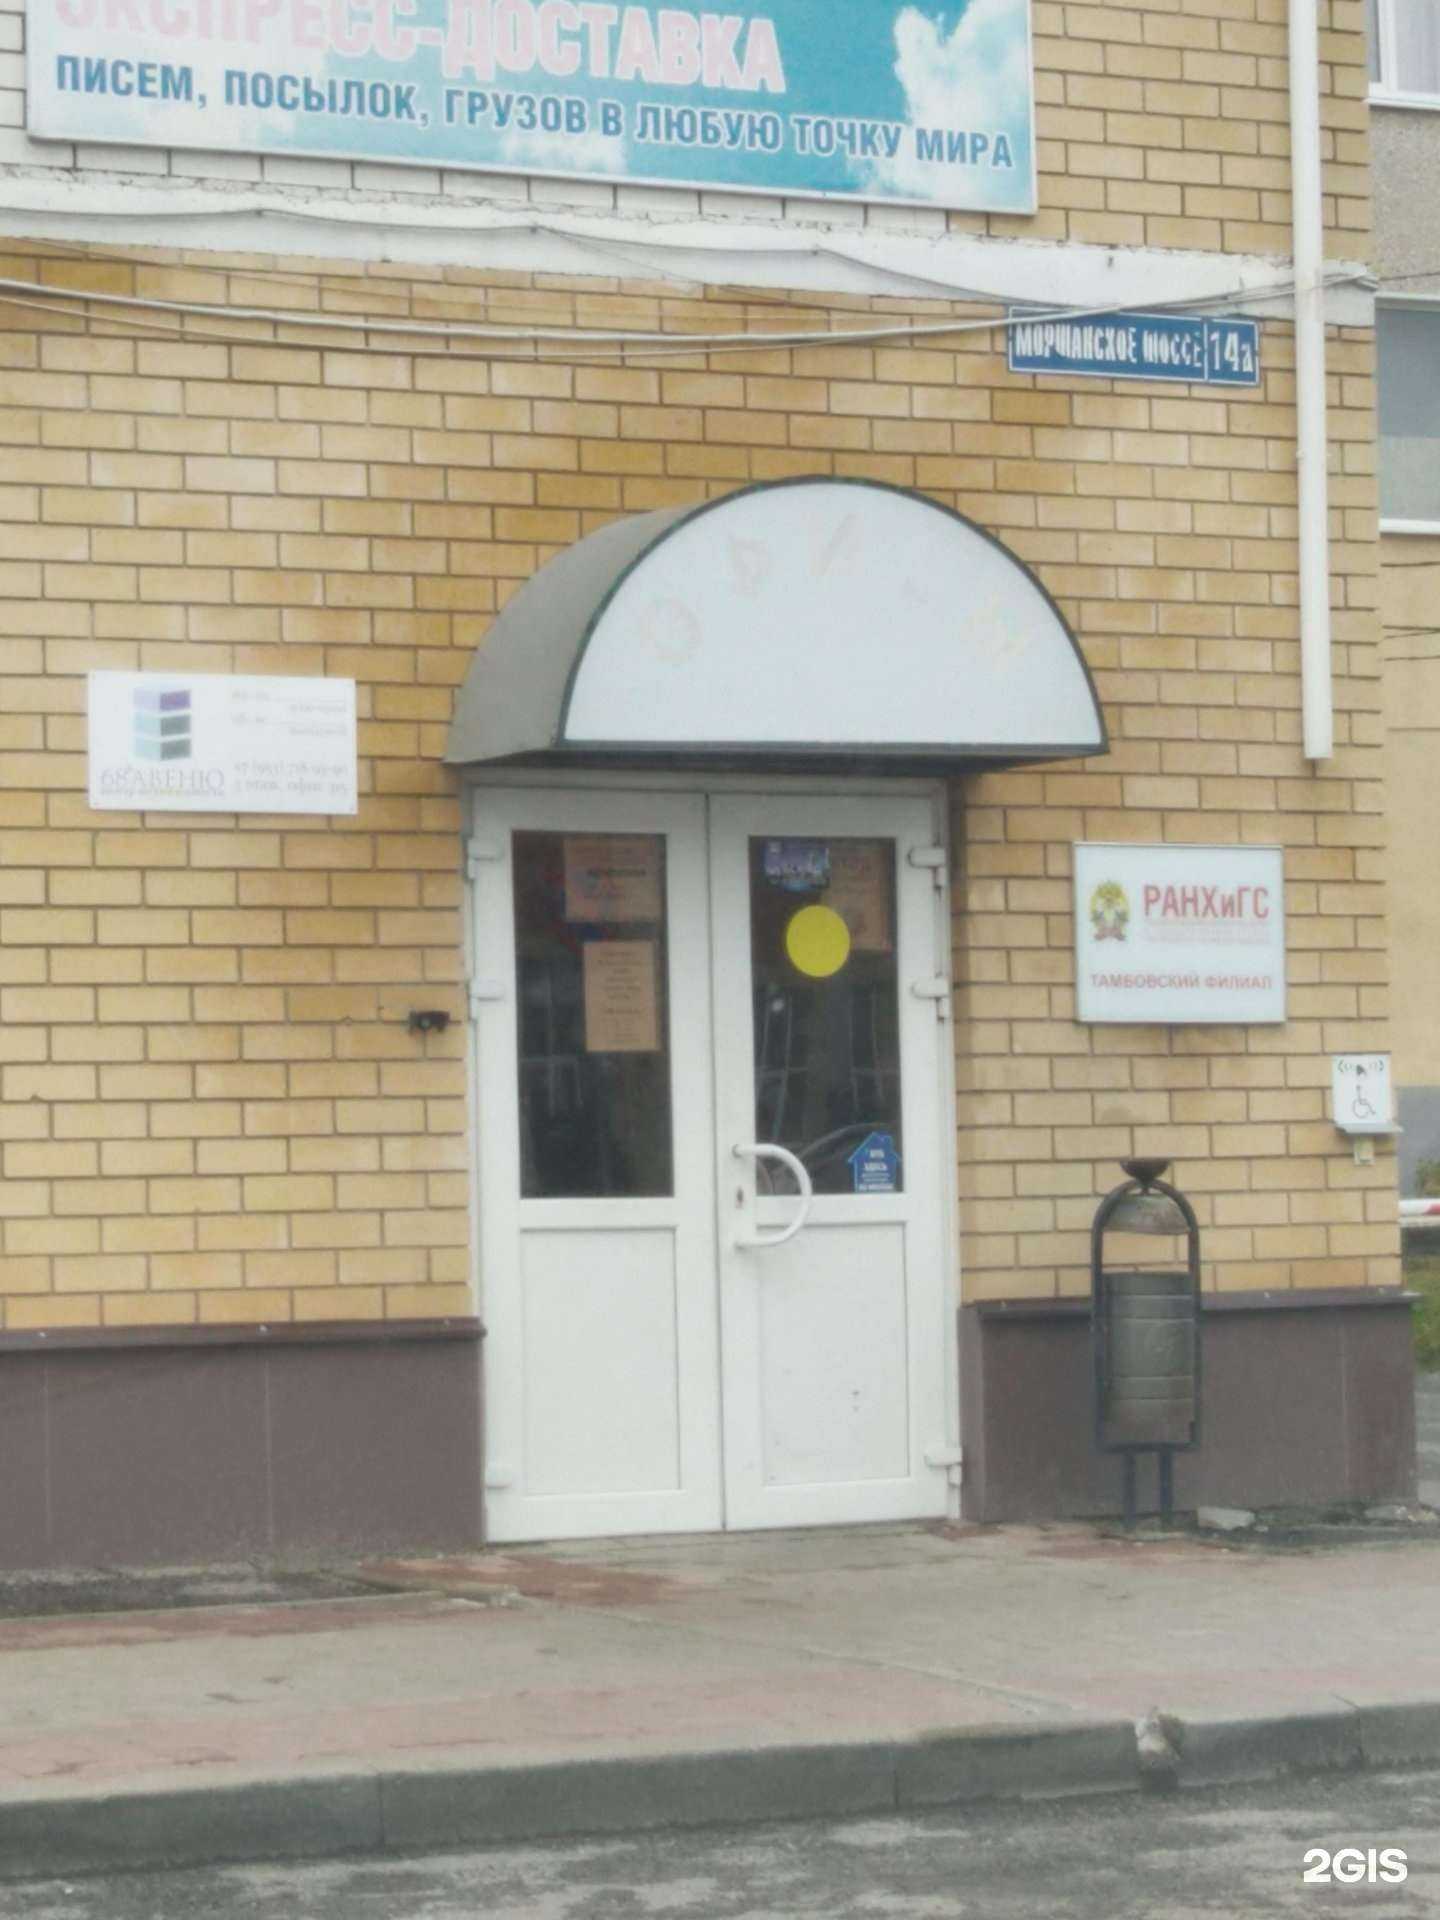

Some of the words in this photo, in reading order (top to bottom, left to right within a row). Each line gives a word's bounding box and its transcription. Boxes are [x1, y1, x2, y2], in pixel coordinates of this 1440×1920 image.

[57, 54, 206, 109] ПИСЕМ,
[225, 69, 428, 127] ПОСЫЛОК,
[445, 89, 587, 134] ГРУЗОВ
[601, 102, 623, 137] В
[637, 105, 781, 152] ЛЮБУЮ
[793, 117, 901, 158] ТОЧКУ
[915, 127, 1013, 168] МИРА
[1143, 884, 1270, 919] РАНХиГС
[1090, 971, 1200, 989] ТАМБОВСКИЙ
[1204, 975, 1272, 990] ФИЛИАЛ
